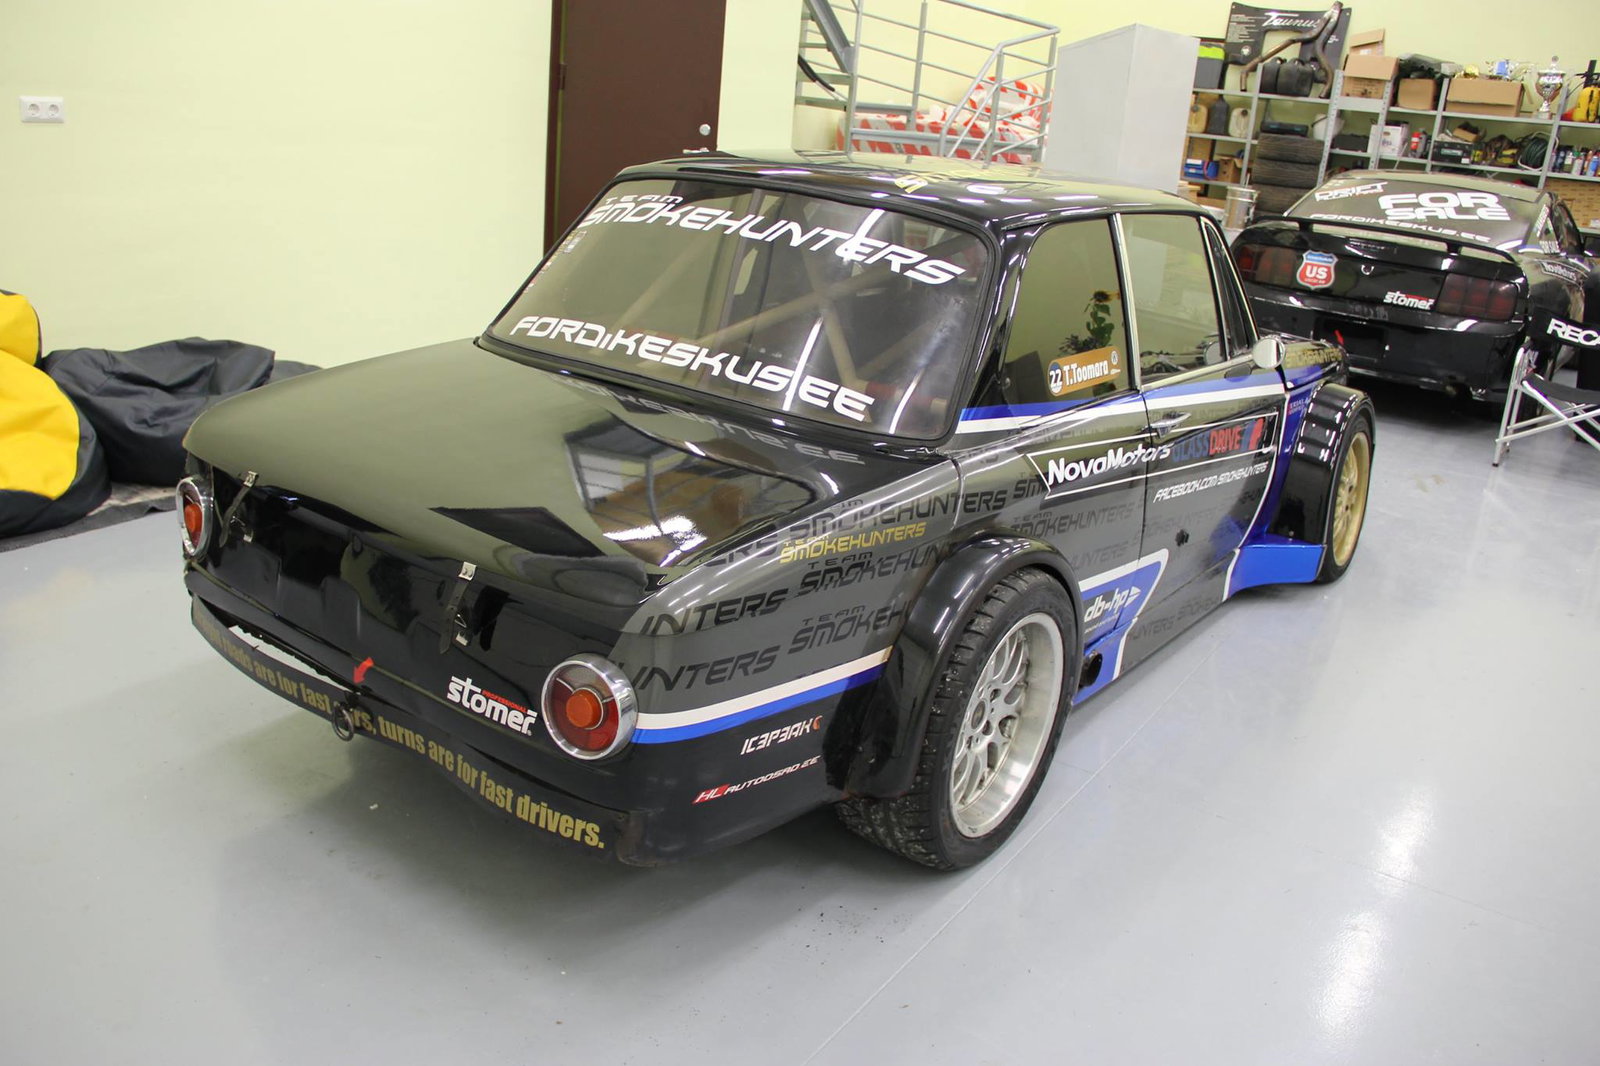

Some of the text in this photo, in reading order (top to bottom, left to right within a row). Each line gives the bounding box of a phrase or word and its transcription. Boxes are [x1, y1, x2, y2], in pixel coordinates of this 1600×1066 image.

[604, 194, 684, 205] TEAM
[1378, 191, 1500, 210] FOR
[1385, 205, 1511, 221] SALE
[577, 201, 967, 286] SMOKEHUNTERS
[1305, 264, 1329, 280] US
[1383, 290, 1436, 310] stomer
[1049, 368, 1063, 387] 22
[1048, 443, 1175, 486] NovaMotors
[779, 522, 928, 563] SMOKEHUNTERS
[808, 551, 873, 569] TEAM
[803, 605, 866, 624] TEAM
[447, 676, 538, 735] stomer
[253, 661, 277, 687] are
[277, 671, 299, 698] for
[300, 682, 331, 714] fast
[378, 715, 425, 755] turns
[427, 740, 455, 772] are
[457, 754, 479, 789] for
[480, 770, 513, 813] fast
[516, 794, 605, 849] drivers.
